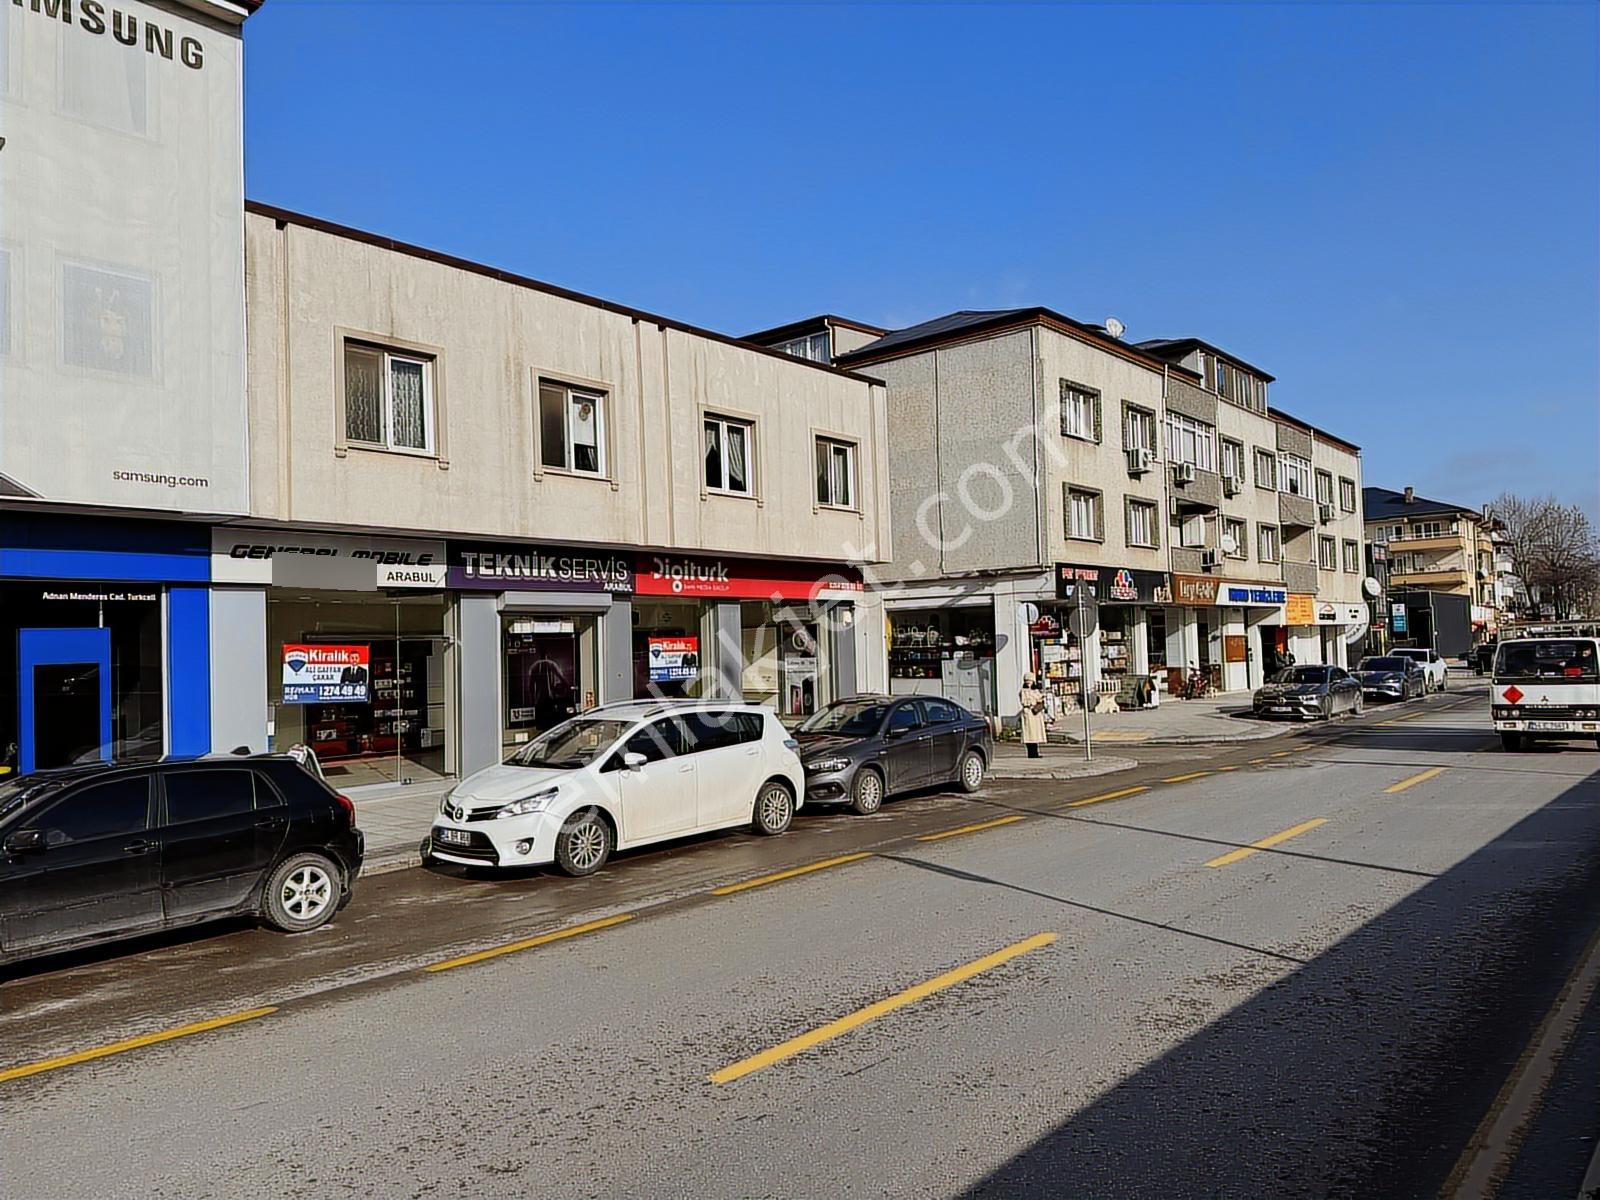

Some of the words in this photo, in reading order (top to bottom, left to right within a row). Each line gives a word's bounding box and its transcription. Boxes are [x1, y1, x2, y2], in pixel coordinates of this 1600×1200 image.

[113, 470, 208, 488] samsung.com
[386, 571, 436, 583] ARABUL
[651, 557, 729, 592] Digiturk
[42, 591, 69, 601] Adnan
[309, 649, 349, 663] Kiralık
